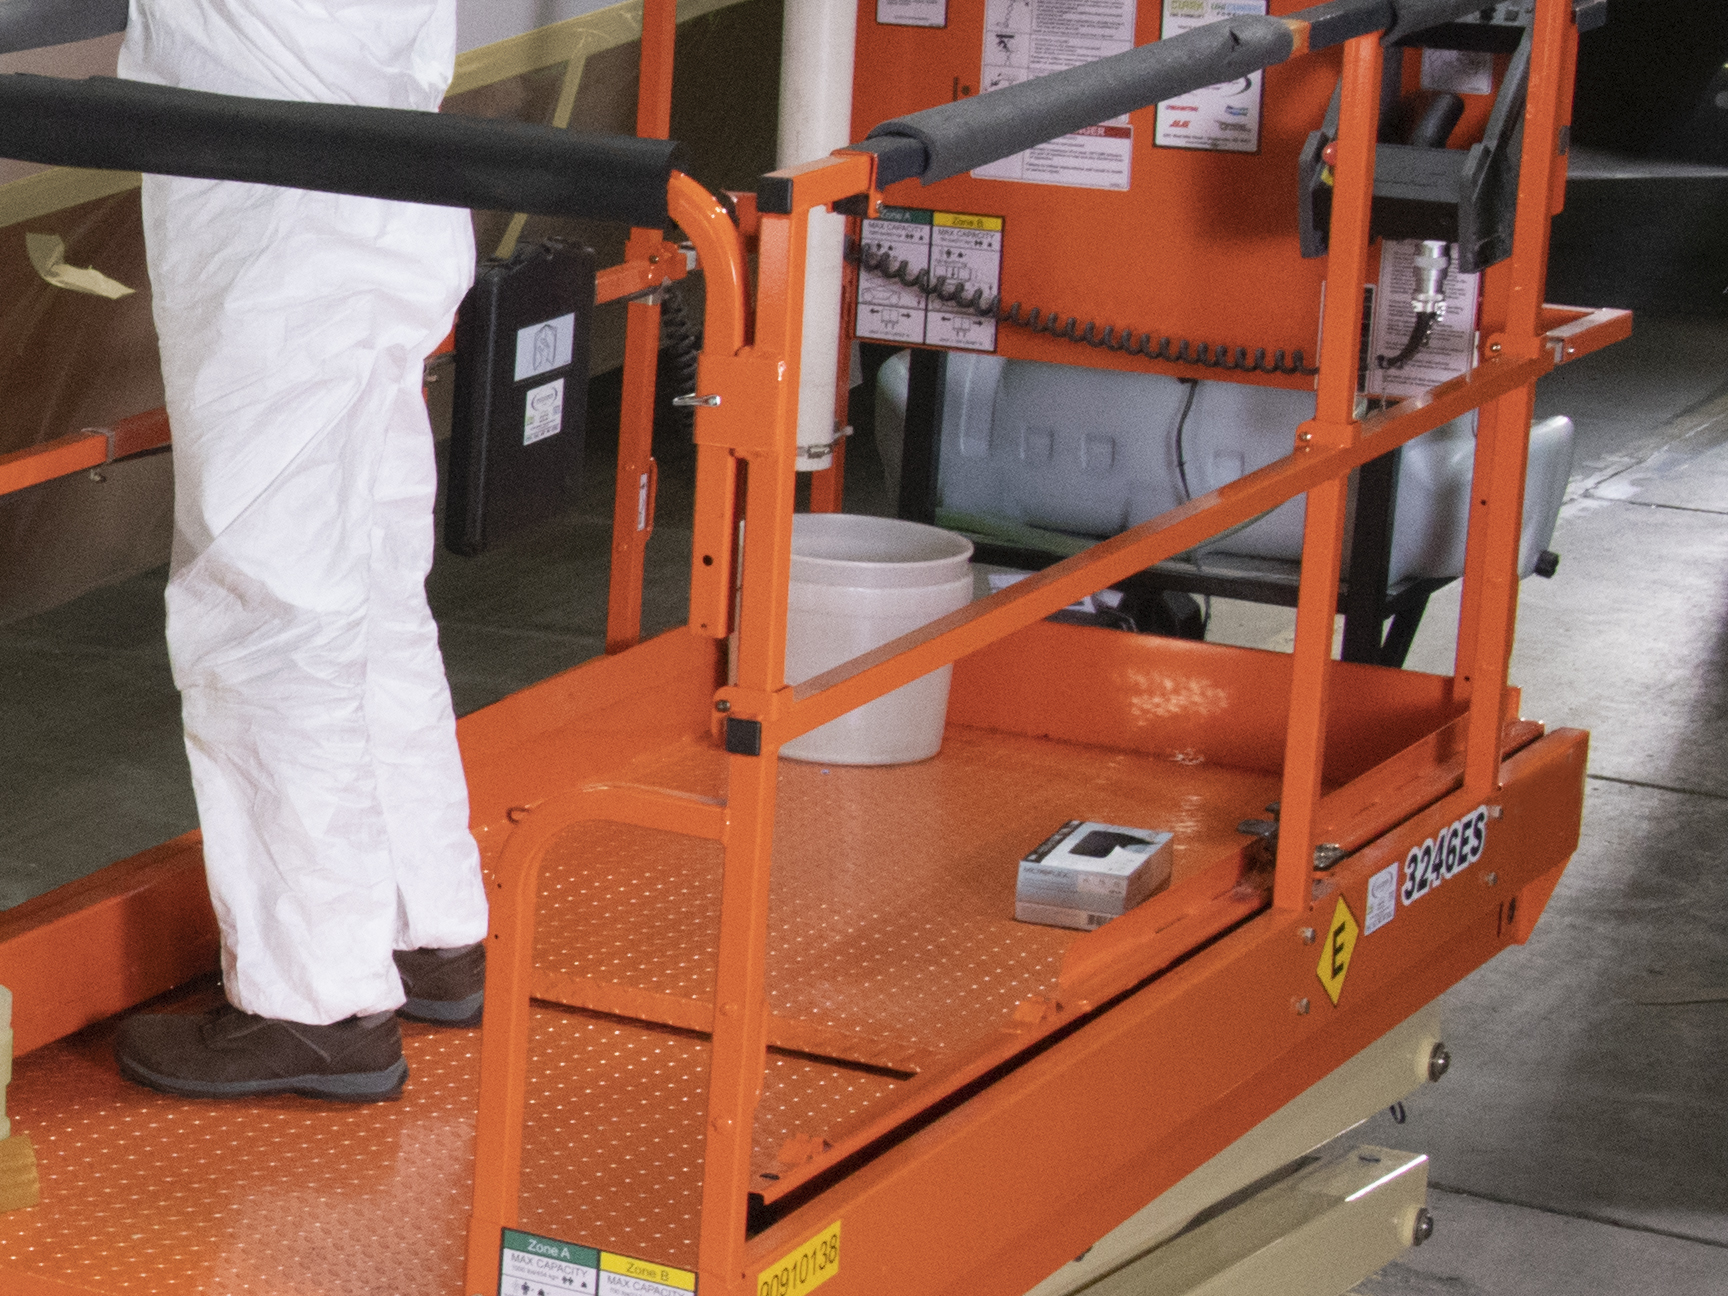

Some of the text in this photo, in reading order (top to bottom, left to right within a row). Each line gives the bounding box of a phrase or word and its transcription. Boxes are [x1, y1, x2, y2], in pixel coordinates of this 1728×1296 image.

[952, 217, 974, 227] Zone
[1403, 811, 1486, 901] 3246ES
[1331, 921, 1346, 980] E
[528, 1239, 570, 1260] Zone A
[511, 1253, 588, 1277] MAX CAPACITY
[626, 1261, 669, 1282] Zone B
[607, 1275, 630, 1288] MAX
